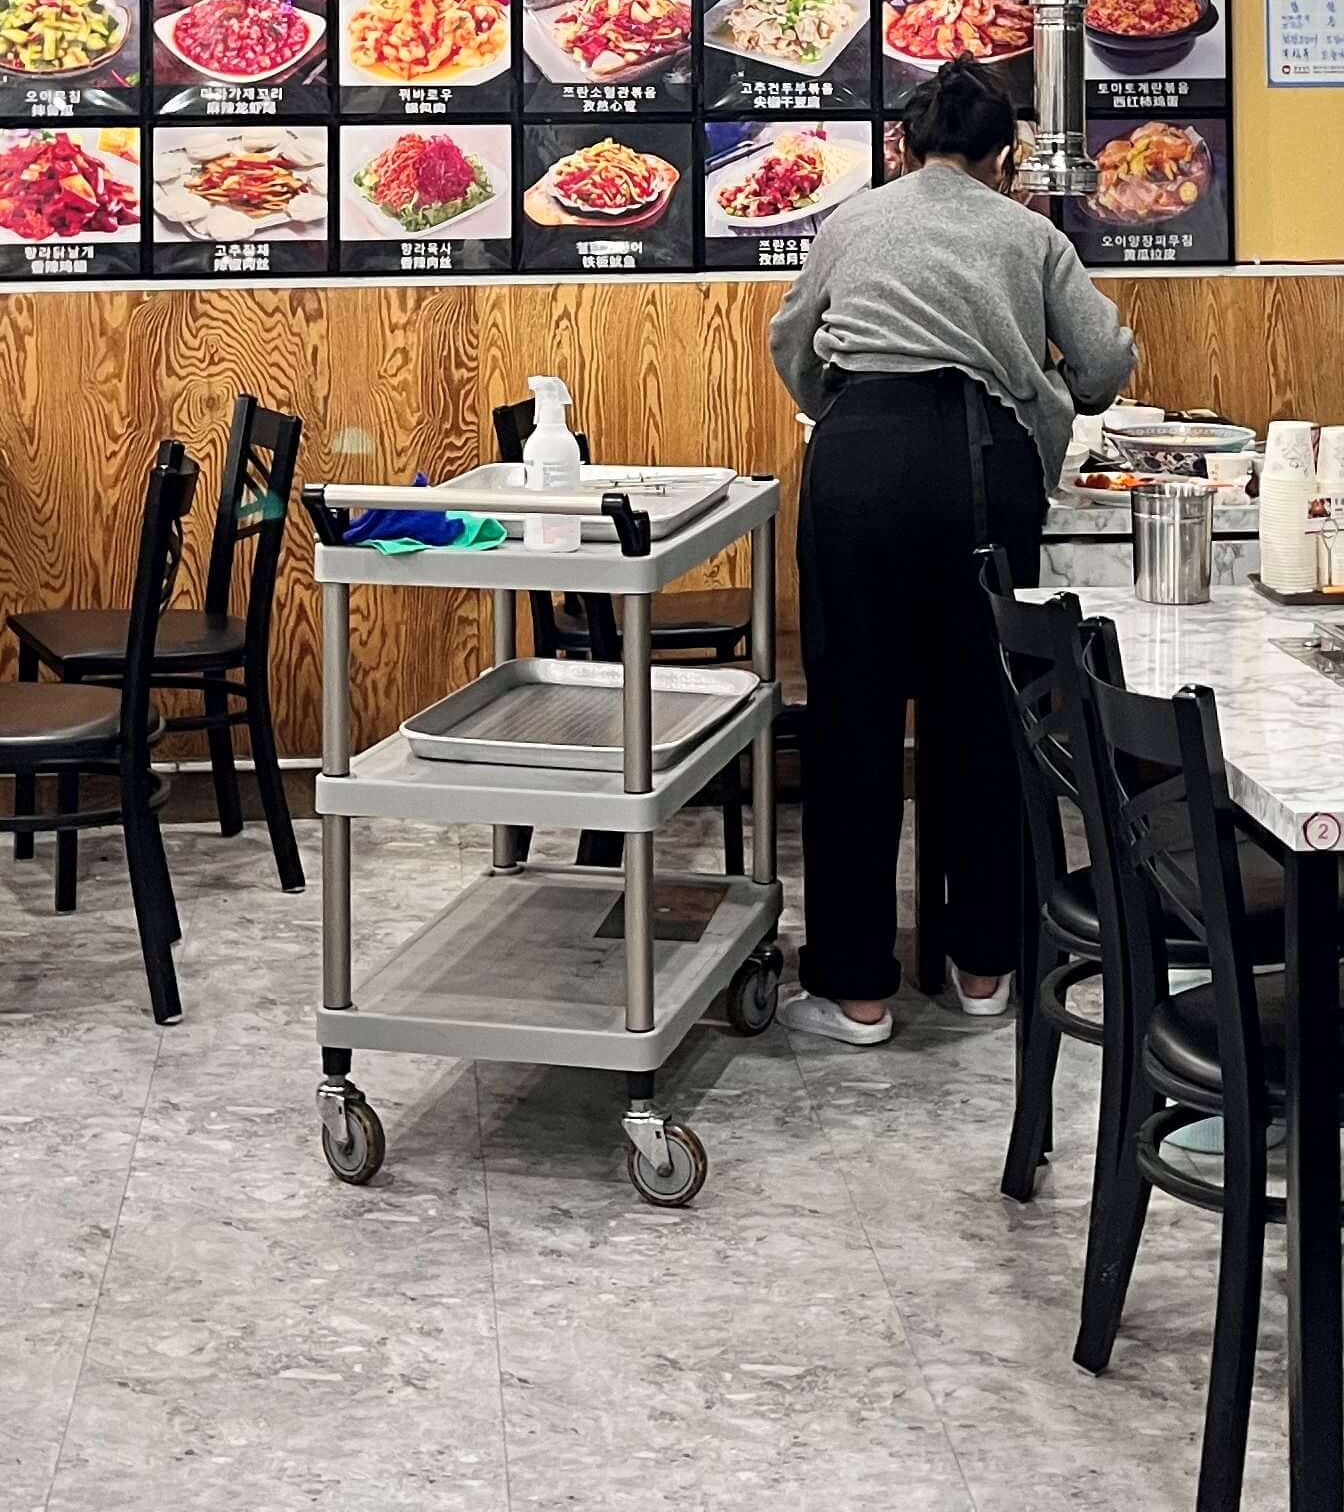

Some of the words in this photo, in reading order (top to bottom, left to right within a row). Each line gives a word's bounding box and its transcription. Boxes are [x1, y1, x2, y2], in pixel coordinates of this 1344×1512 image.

[741, 82, 833, 96] 고추건두부볶음
[1097, 81, 1190, 95] 토마토계란볶음
[1101, 234, 1193, 248] 오이양장피무침
[1318, 823, 1329, 840] 2
